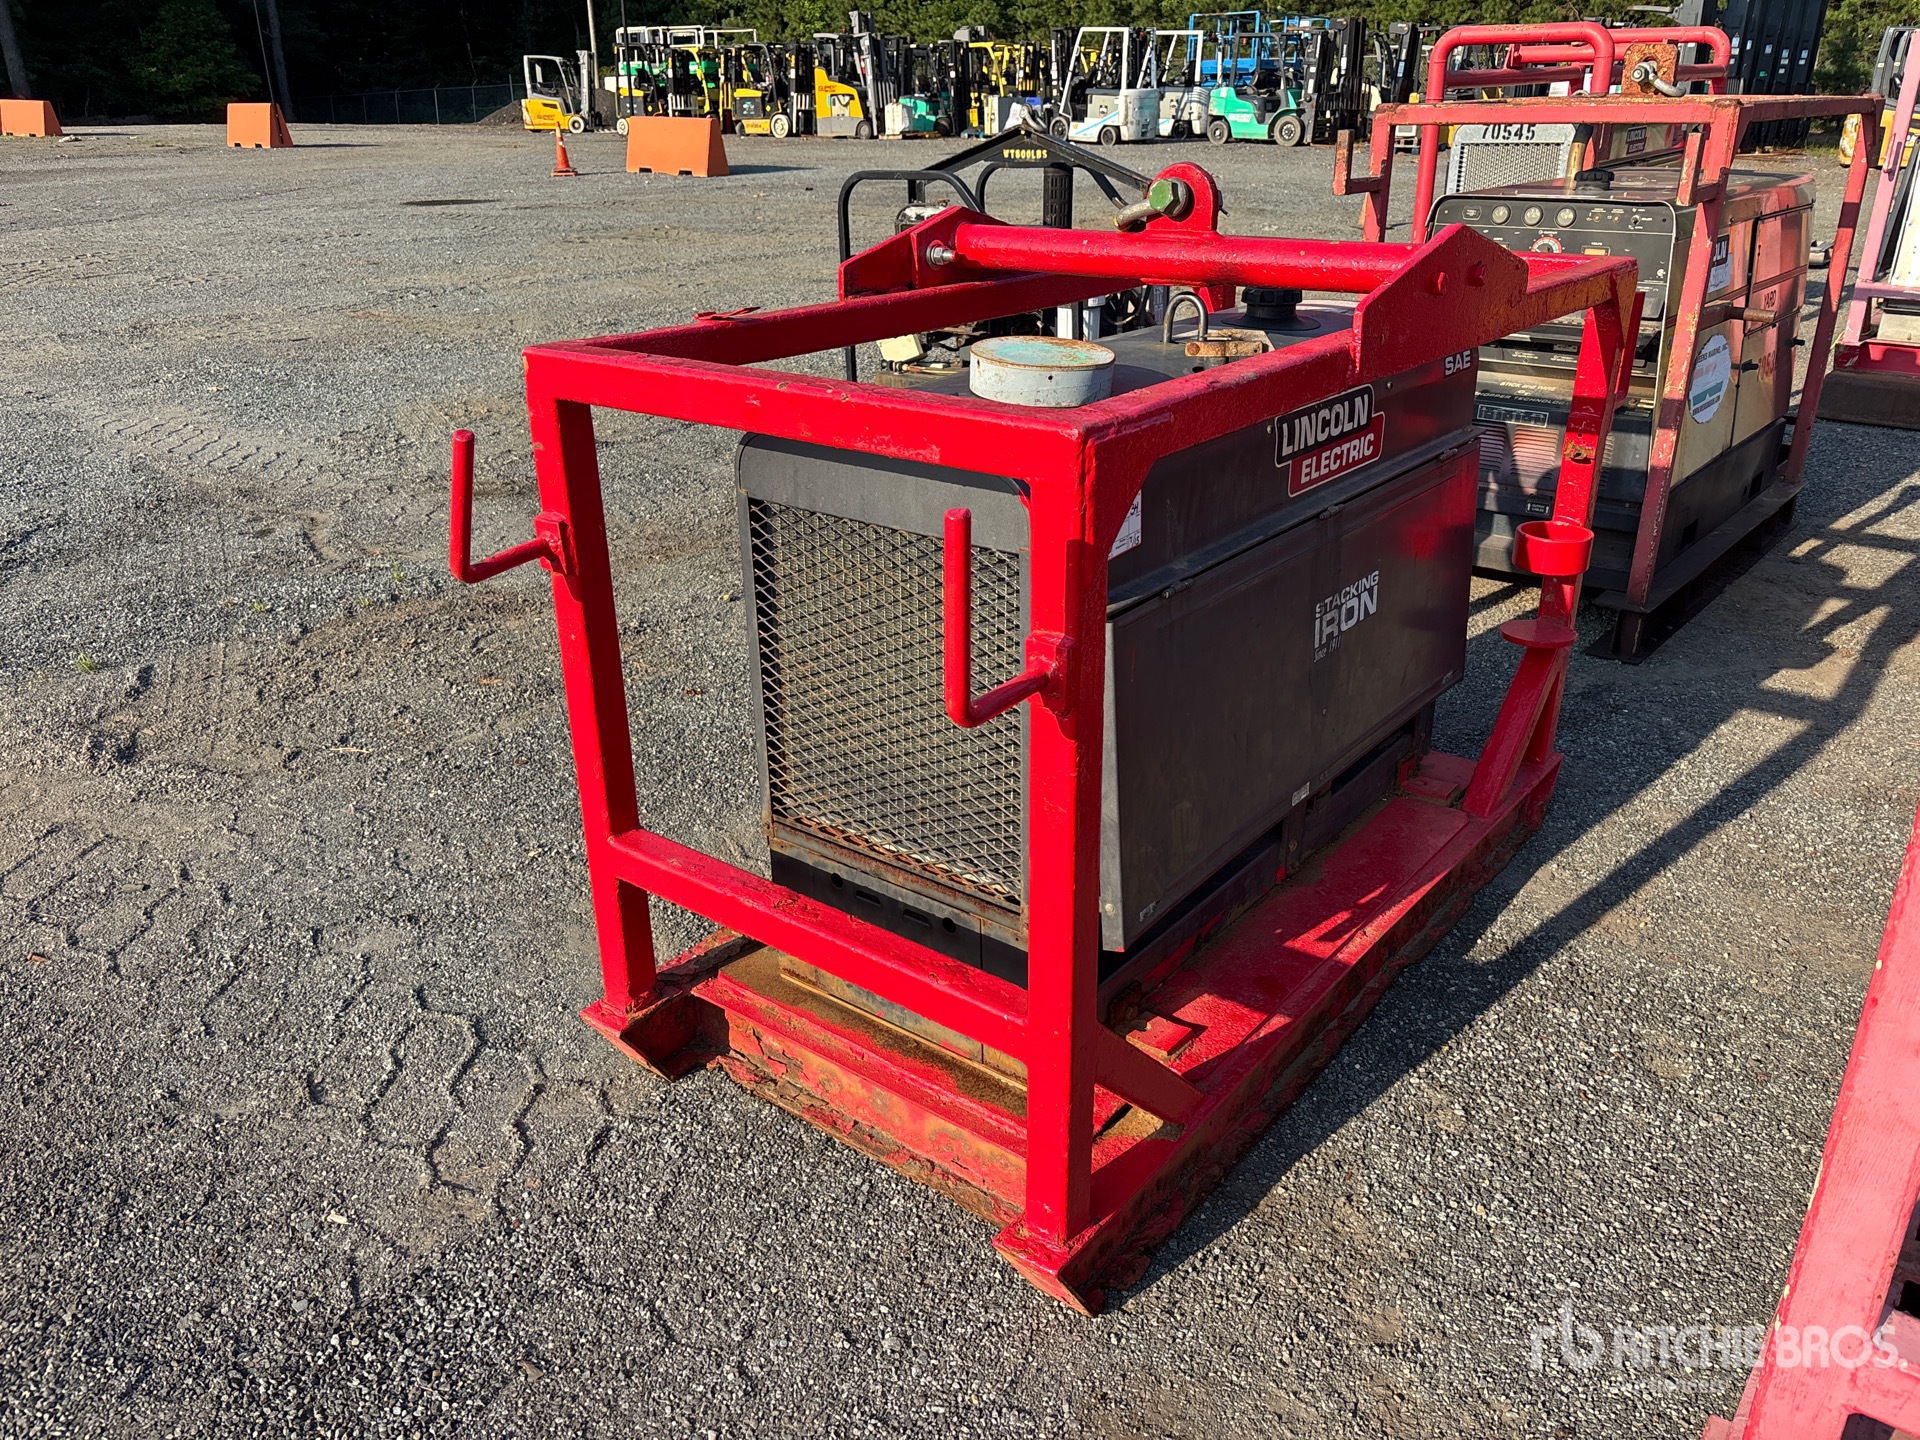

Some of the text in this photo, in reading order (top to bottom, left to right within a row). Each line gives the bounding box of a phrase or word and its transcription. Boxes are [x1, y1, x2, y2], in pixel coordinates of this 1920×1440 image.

[1482, 124, 1536, 140] 70545
[1445, 350, 1471, 376] SAE
[1282, 394, 1369, 457] LINCOLN
[1301, 433, 1374, 484] ELECTRIC
[1315, 570, 1379, 618] STACKING
[1315, 585, 1378, 649] IRON
